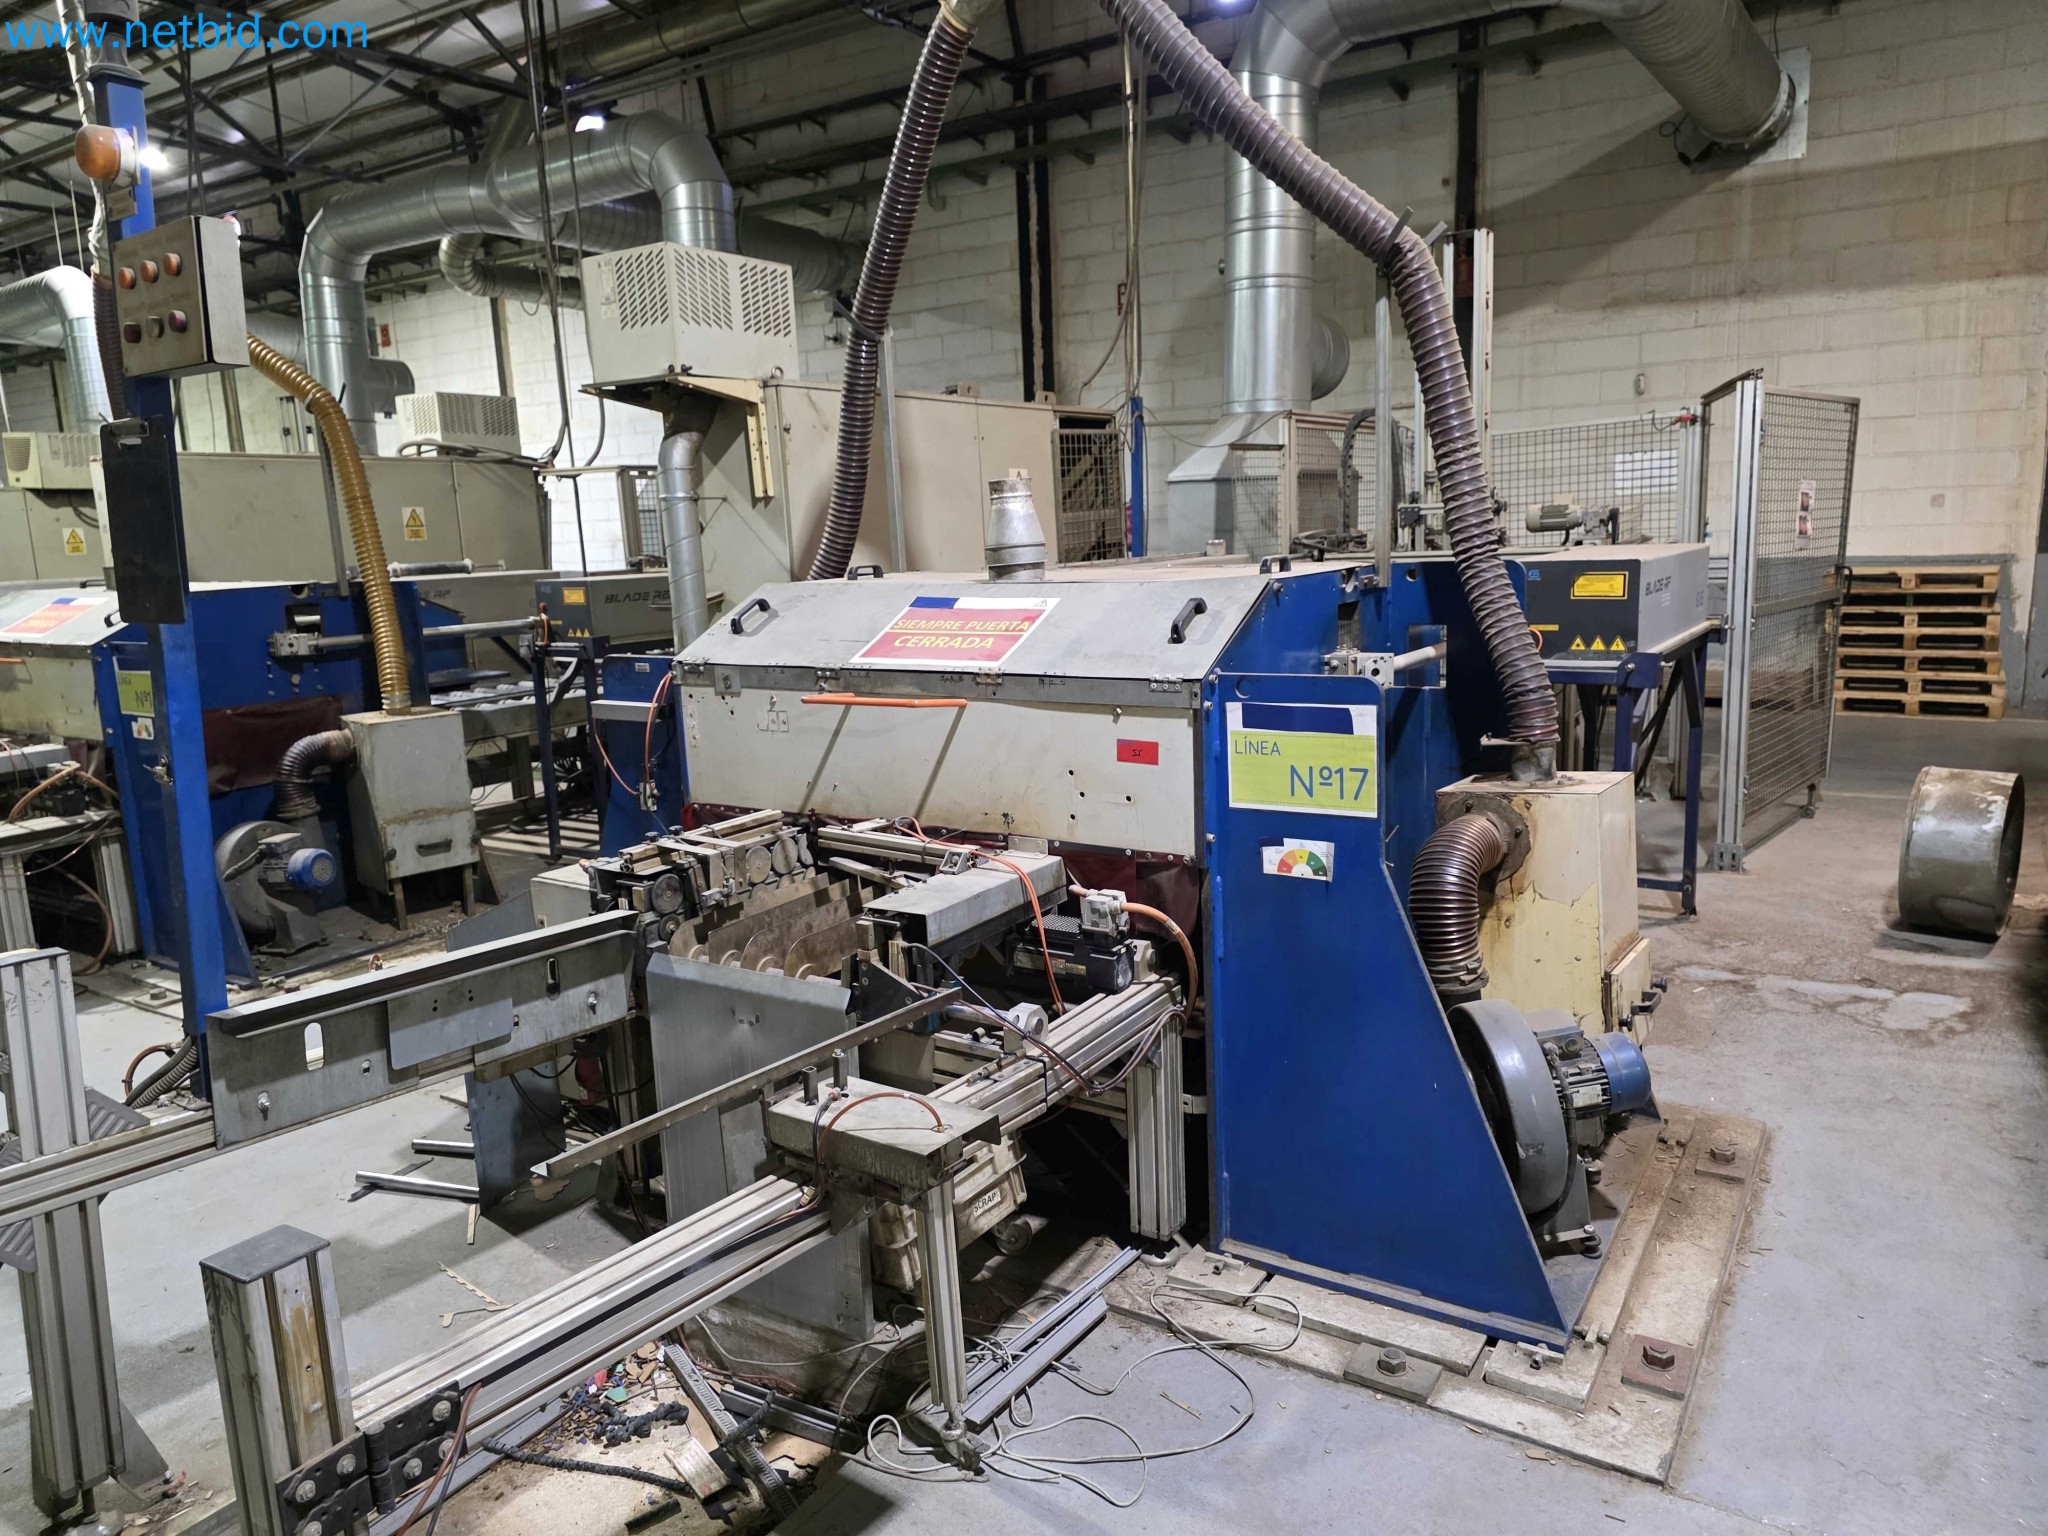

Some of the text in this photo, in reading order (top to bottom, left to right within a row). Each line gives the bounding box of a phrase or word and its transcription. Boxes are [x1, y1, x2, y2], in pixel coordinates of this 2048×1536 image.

[604, 591, 651, 604] BLADE
[893, 618, 1031, 632] SIEMPRE PUERTA
[893, 635, 995, 649] CERRADA
[1234, 735, 1281, 756] LÍNEA
[1290, 764, 1369, 801] Nº17
